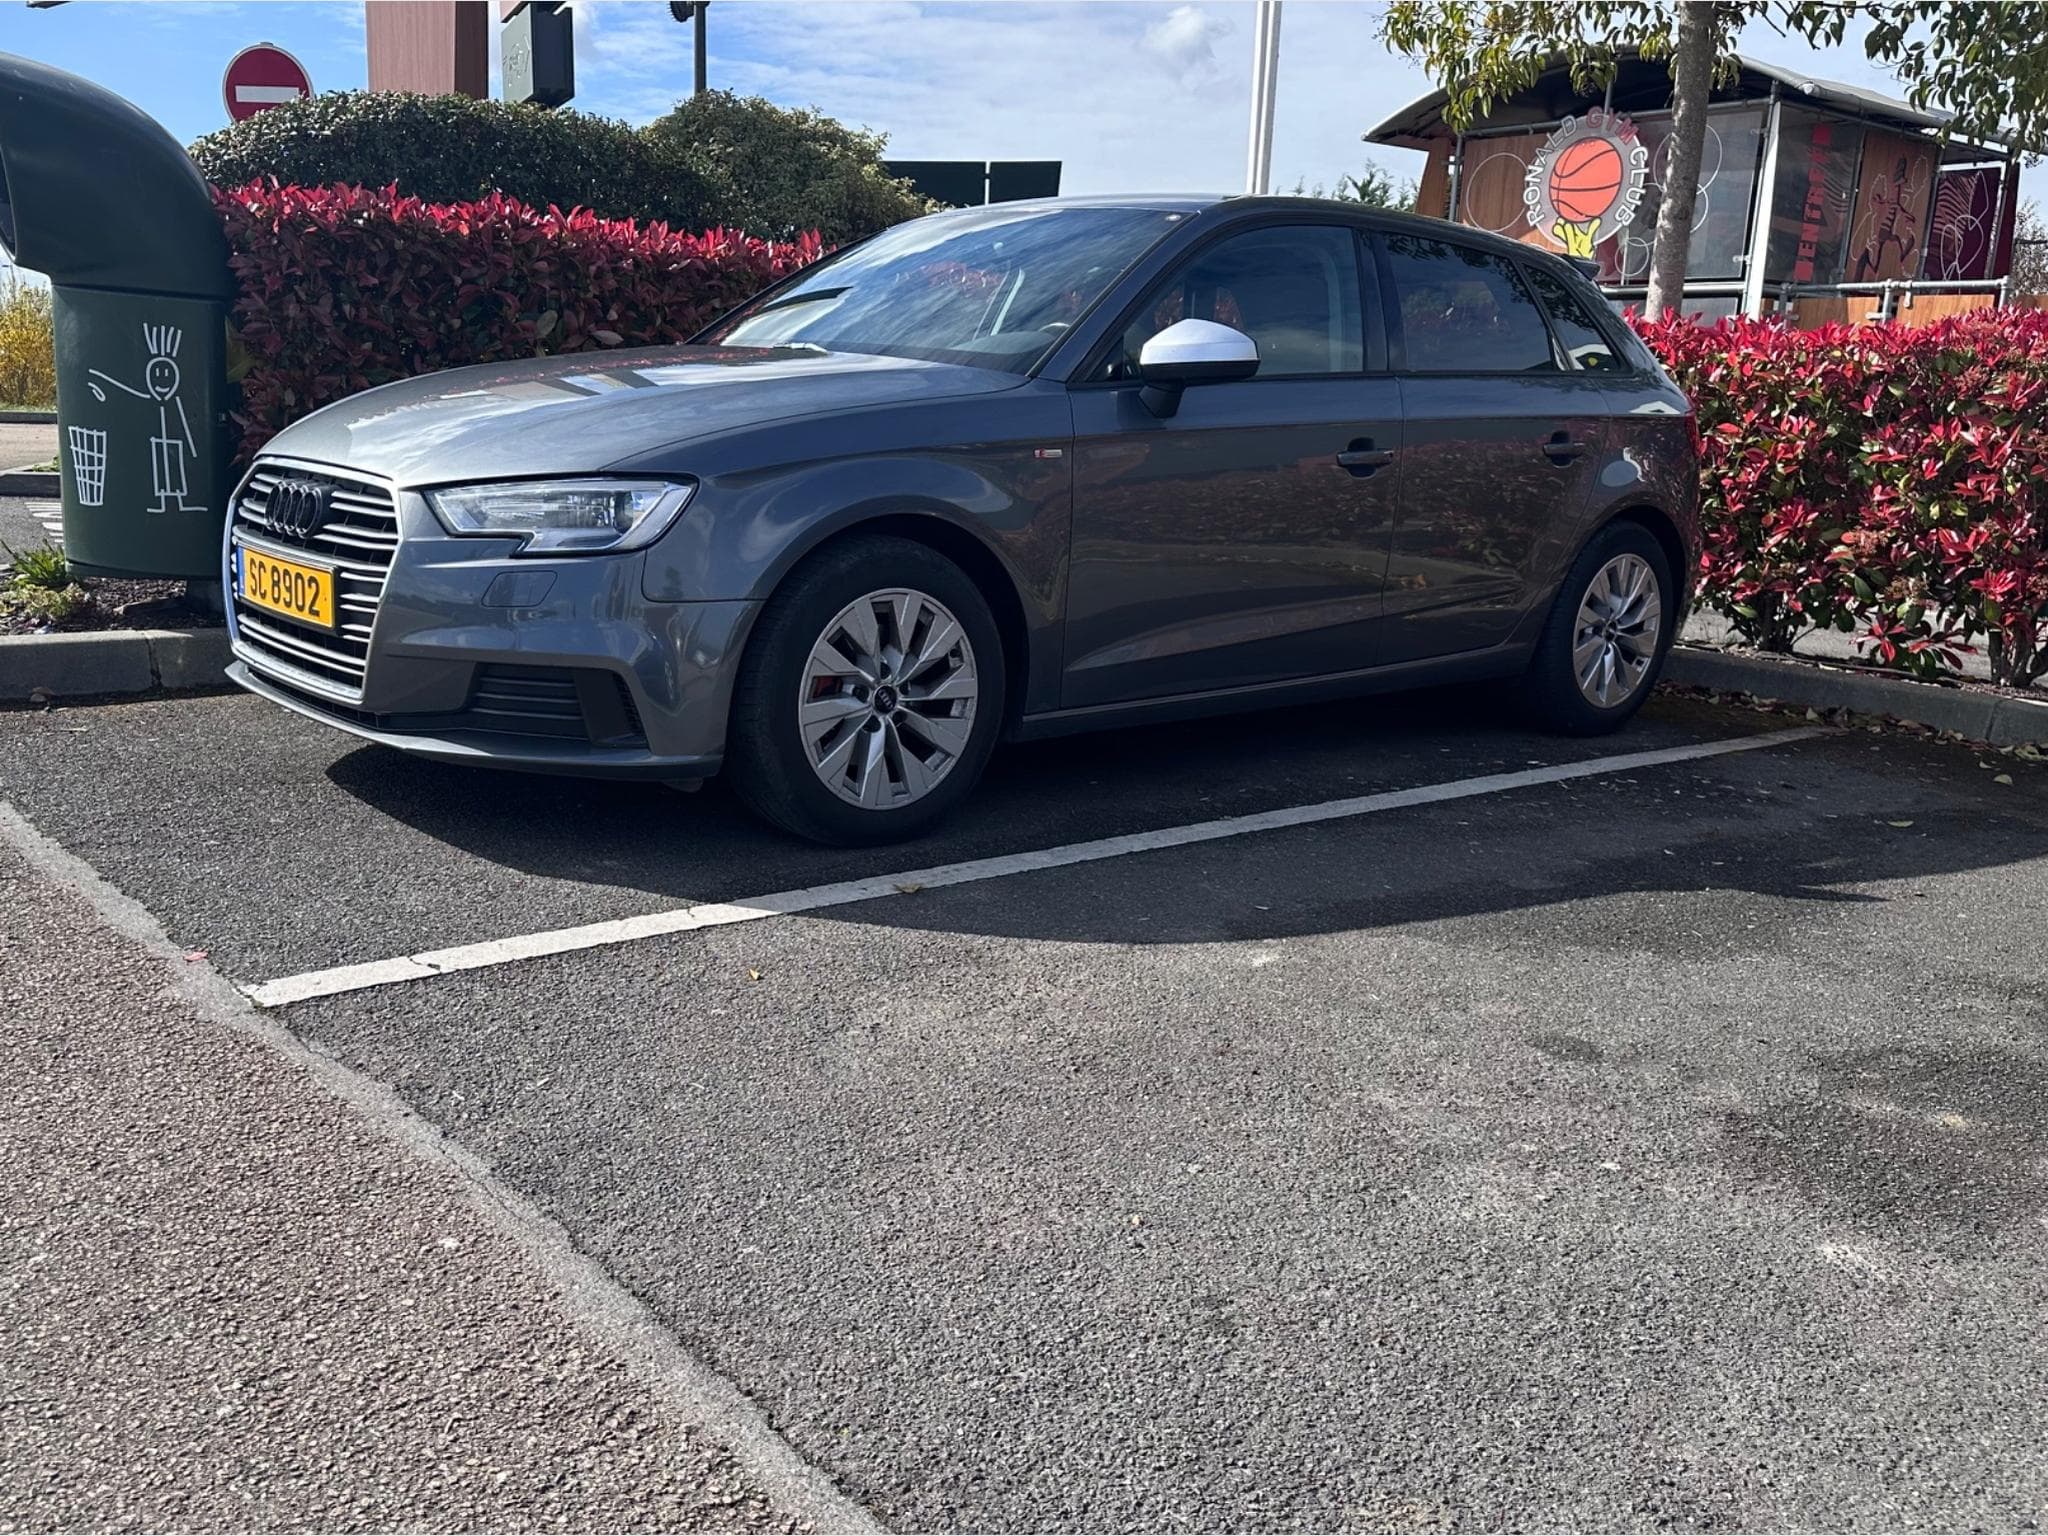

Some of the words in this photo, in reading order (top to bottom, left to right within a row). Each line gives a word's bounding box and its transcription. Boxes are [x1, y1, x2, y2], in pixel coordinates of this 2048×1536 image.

[1523, 115, 1577, 227] RONALD
[1586, 106, 1639, 145] GYM
[1614, 146, 1649, 226] CLUB
[250, 557, 267, 600] SC
[271, 565, 321, 617] 8902
